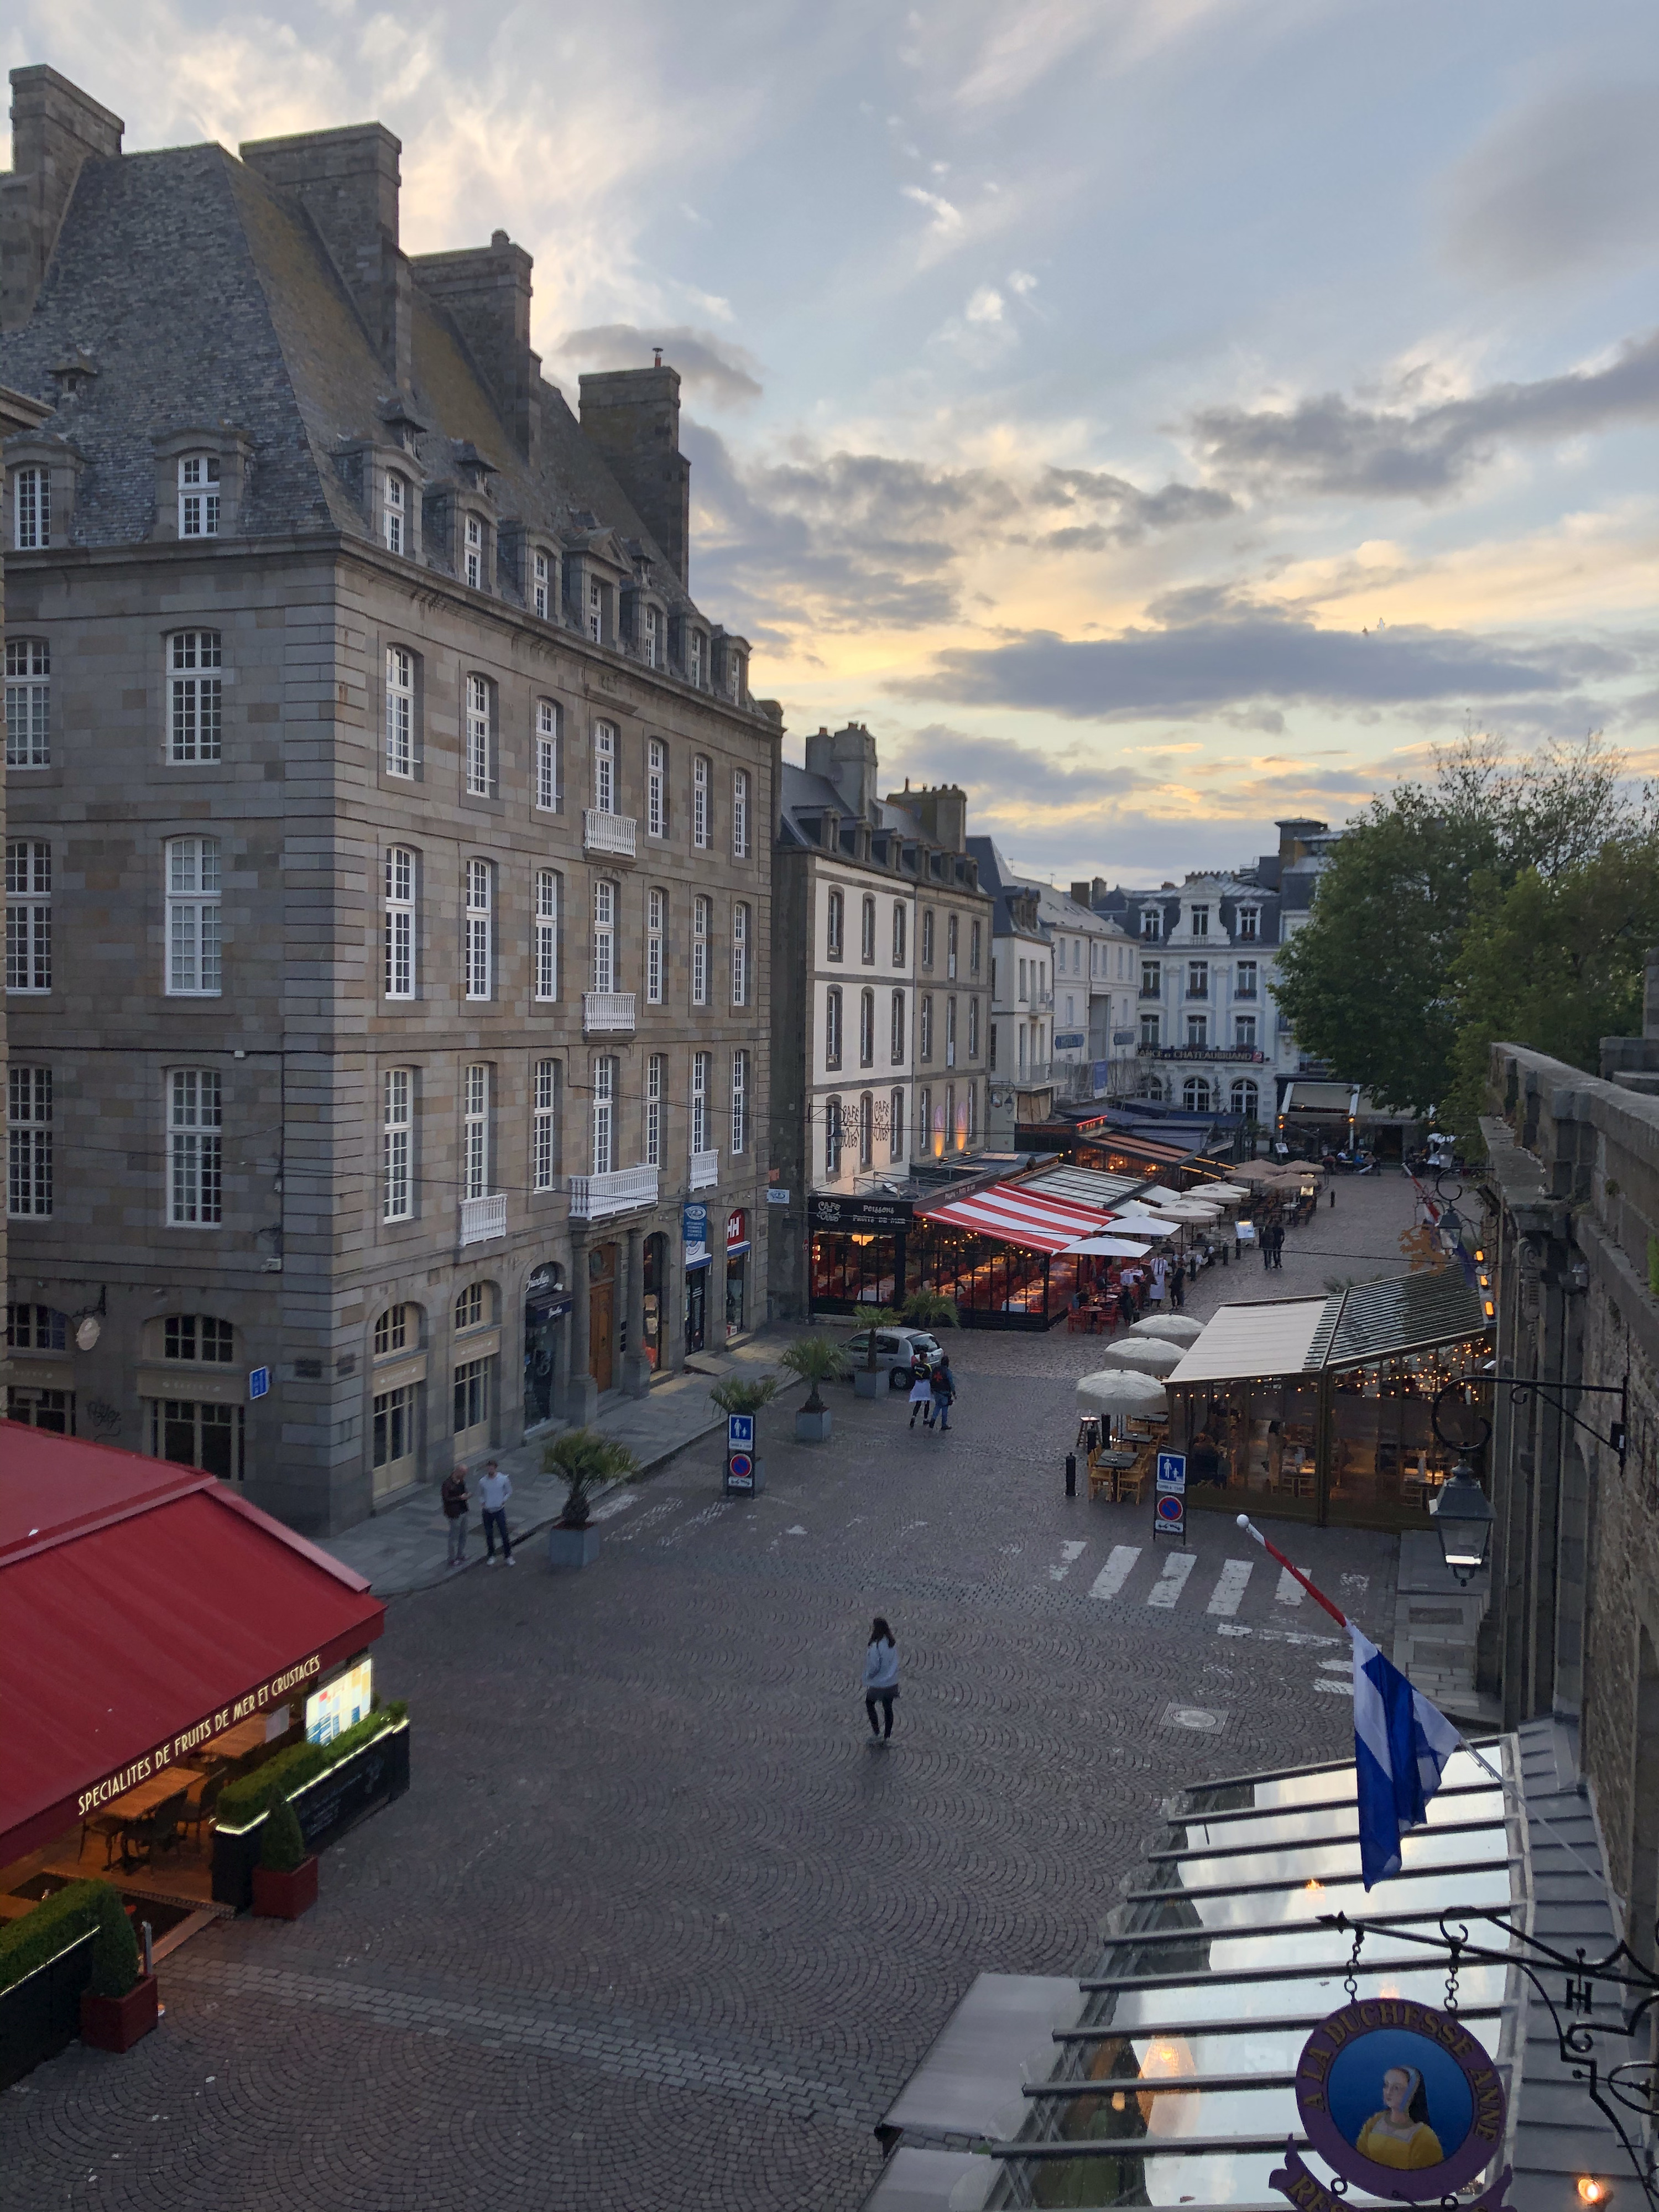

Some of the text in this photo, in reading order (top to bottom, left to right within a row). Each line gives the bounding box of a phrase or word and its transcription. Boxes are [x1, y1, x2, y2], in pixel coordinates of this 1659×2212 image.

[863, 1204, 895, 1214] POISSONS
[78, 1655, 321, 1815] SPECIALITES DE FRUITS DE MER ET CRUSTACES
[1302, 2000, 1502, 2143] A LA DUCHESSE ANNE
